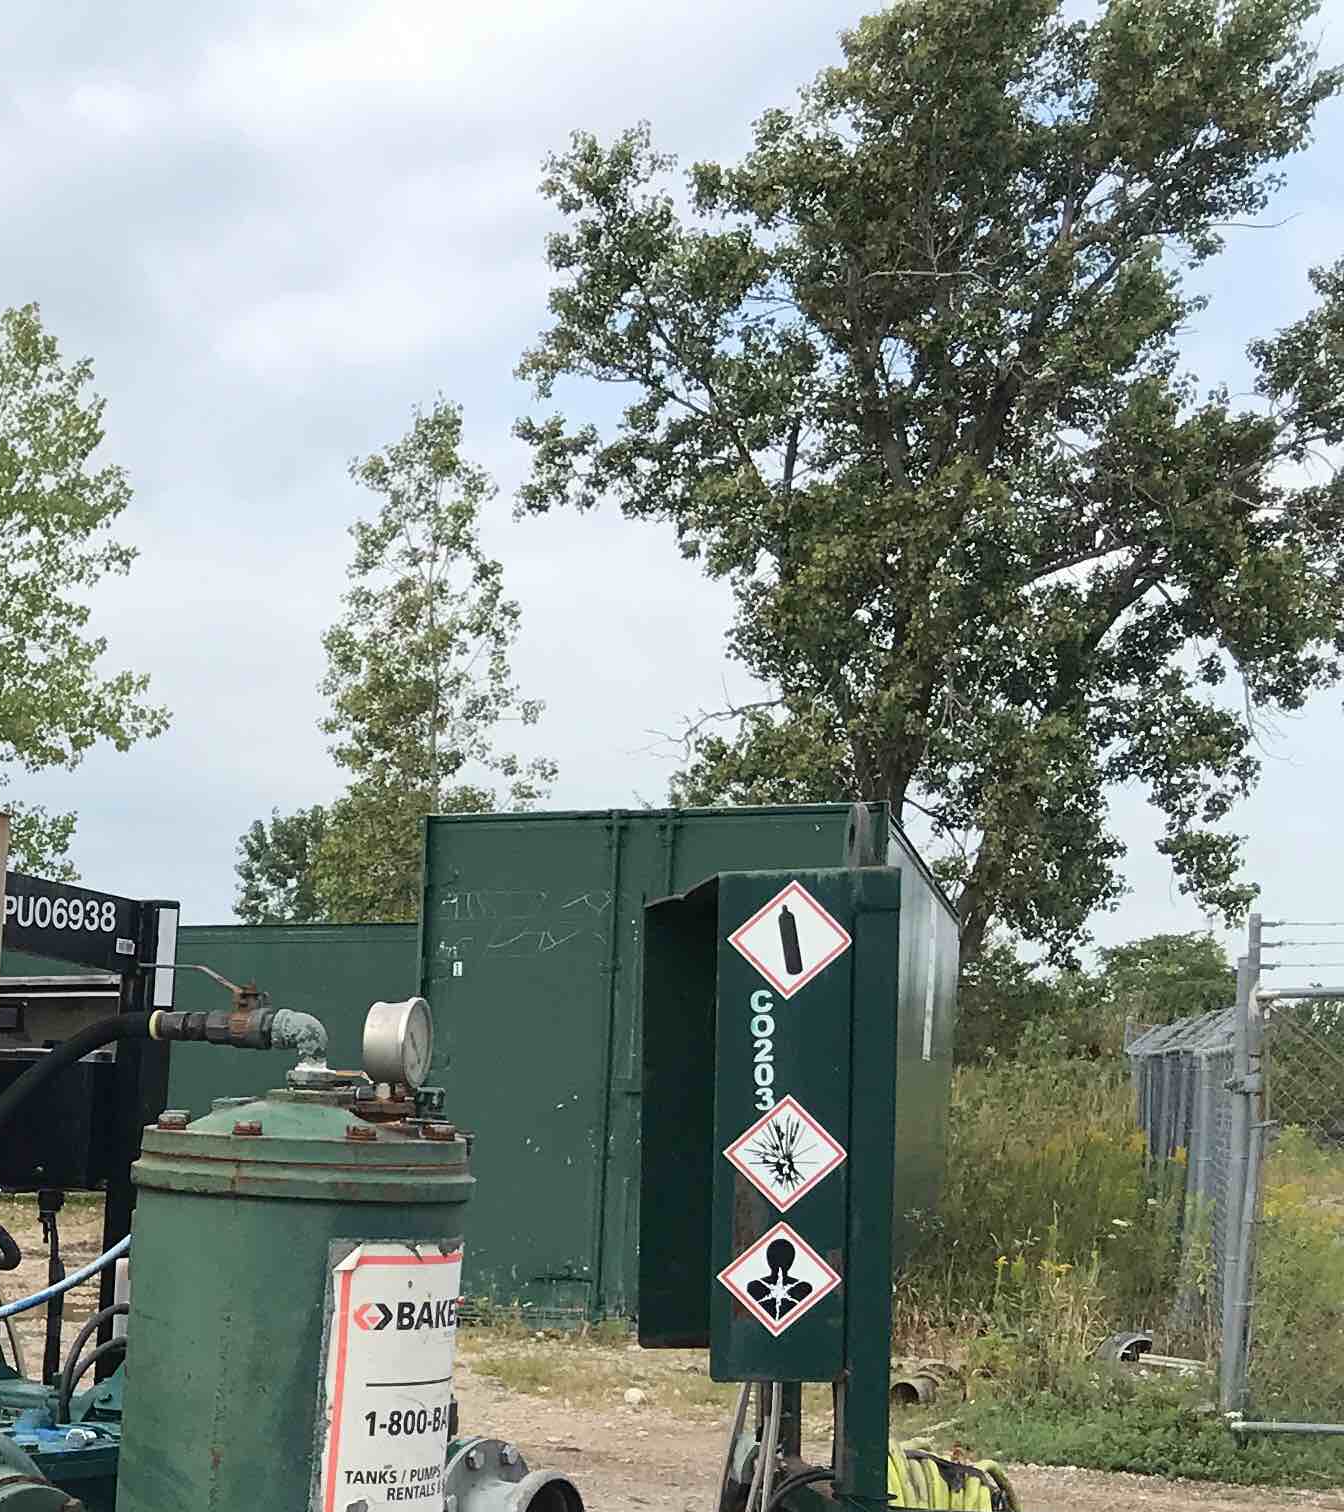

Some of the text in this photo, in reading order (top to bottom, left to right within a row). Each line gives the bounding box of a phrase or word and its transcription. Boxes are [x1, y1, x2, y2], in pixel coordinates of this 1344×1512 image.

[2, 895, 116, 932] PU06938
[396, 1300, 457, 1330] BAKE
[344, 1468, 397, 1485] TANKS
[386, 1482, 435, 1501] RENTALS
